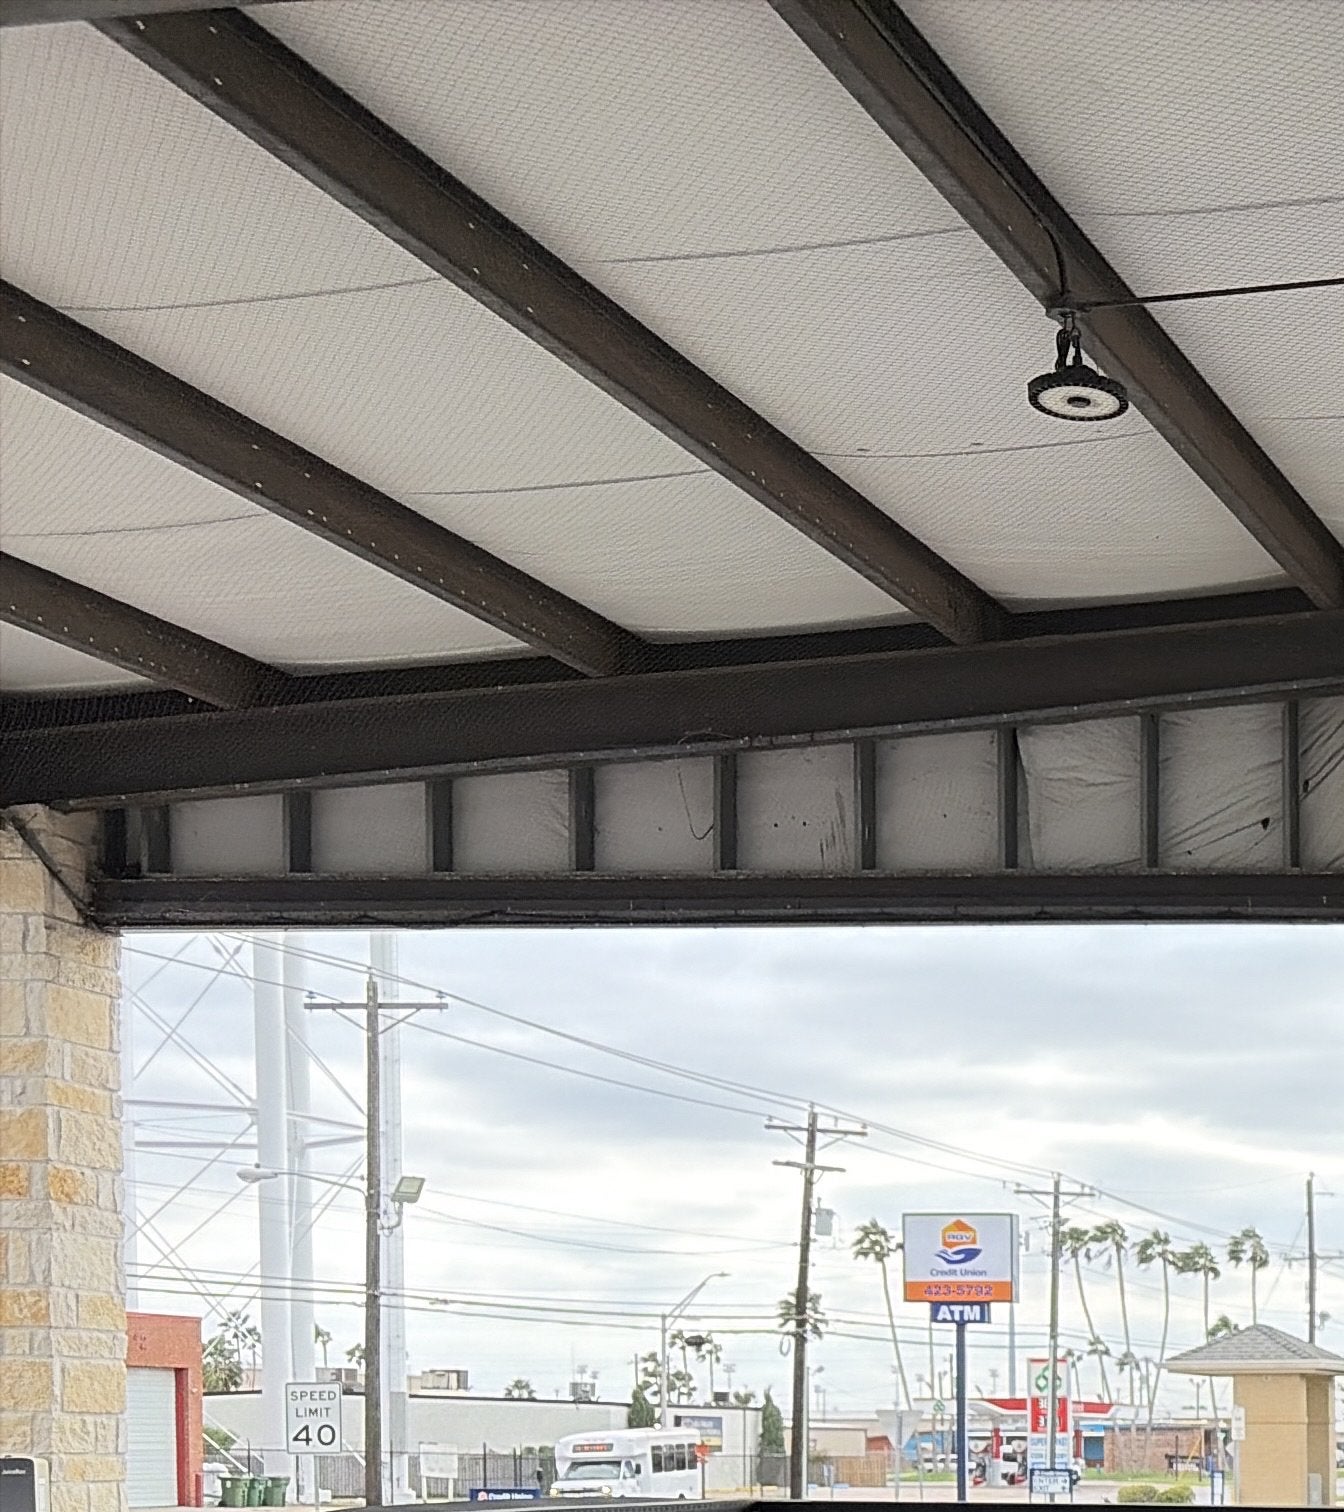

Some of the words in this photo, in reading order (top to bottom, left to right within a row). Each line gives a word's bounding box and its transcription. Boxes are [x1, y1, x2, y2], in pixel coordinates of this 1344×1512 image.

[930, 1268, 958, 1277] Credit
[960, 1268, 987, 1277] Union
[937, 1304, 981, 1321] ATM
[290, 1390, 337, 1402] SPEED
[295, 1407, 331, 1418] LIMIT
[292, 1424, 336, 1446] 40
